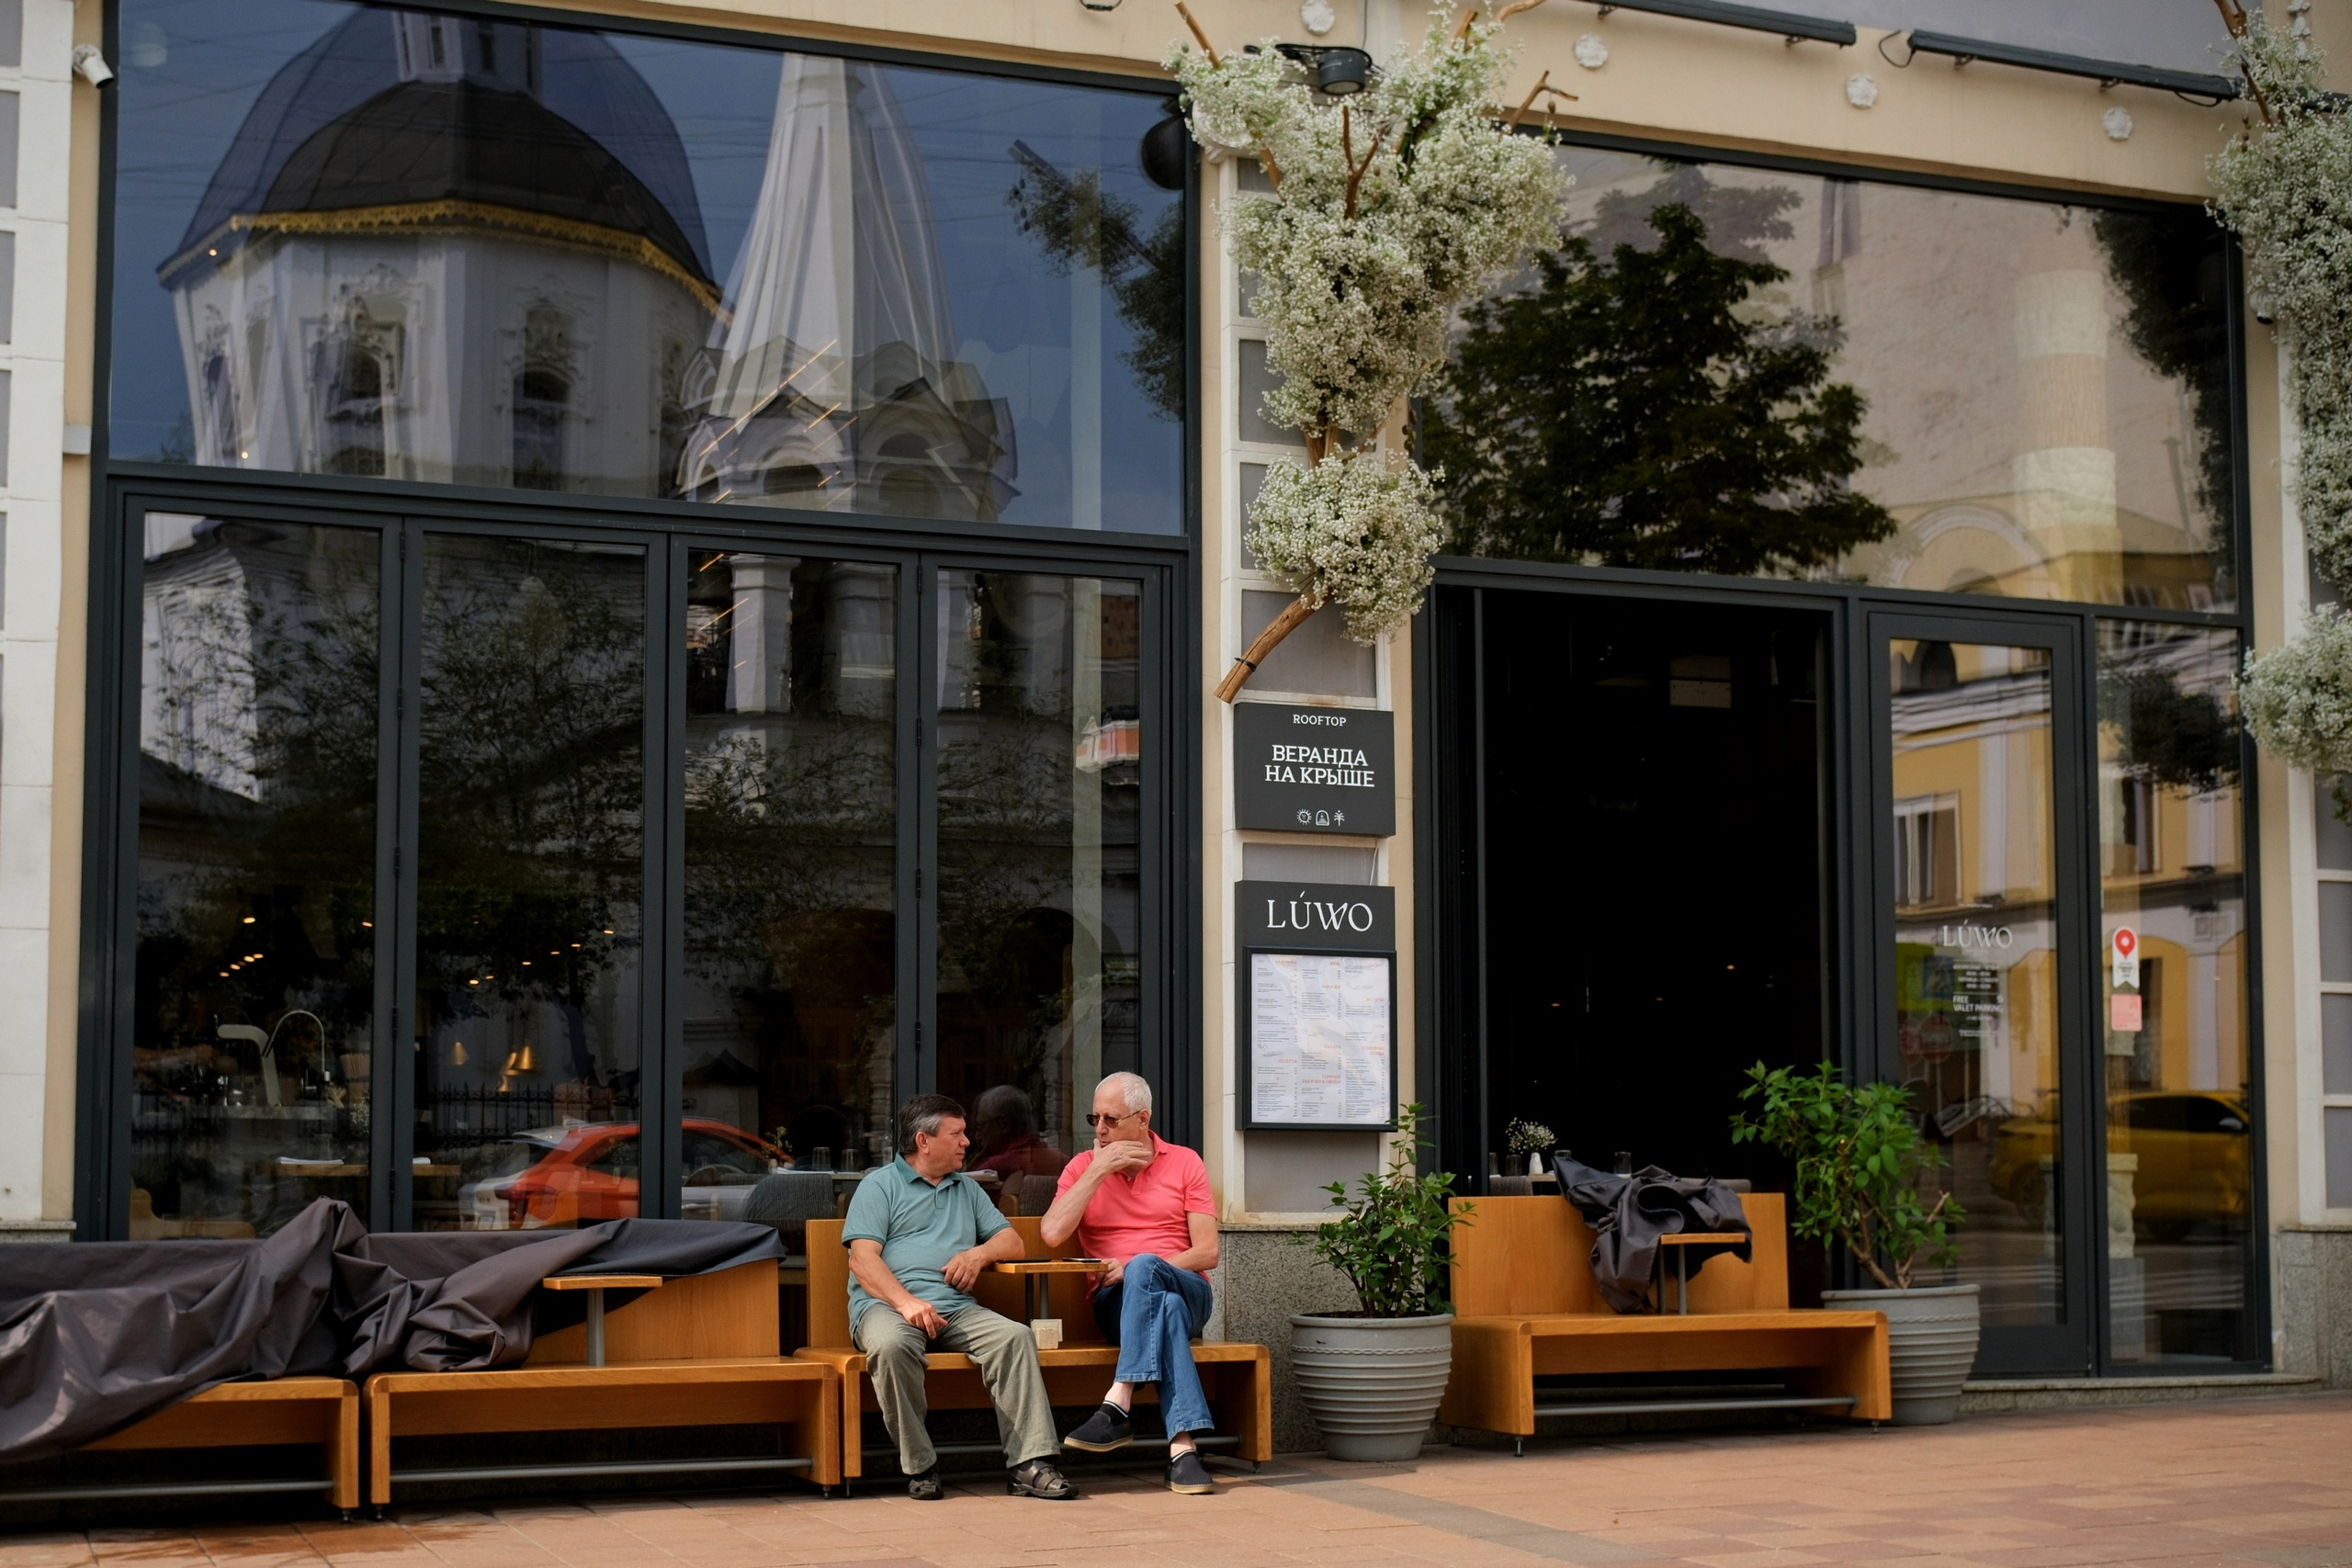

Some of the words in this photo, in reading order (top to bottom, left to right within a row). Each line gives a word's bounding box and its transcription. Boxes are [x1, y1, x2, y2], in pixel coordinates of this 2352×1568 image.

[1293, 714, 1347, 727] ROOFTOP
[1272, 744, 1369, 768] ВЕРАНДА
[1264, 764, 1296, 783] НА
[1299, 766, 1375, 788] КРЫШЕ
[1266, 890, 1374, 932] LÚWO
[1942, 919, 2013, 949] LÚWO
[1952, 995, 1969, 1004] FREE
